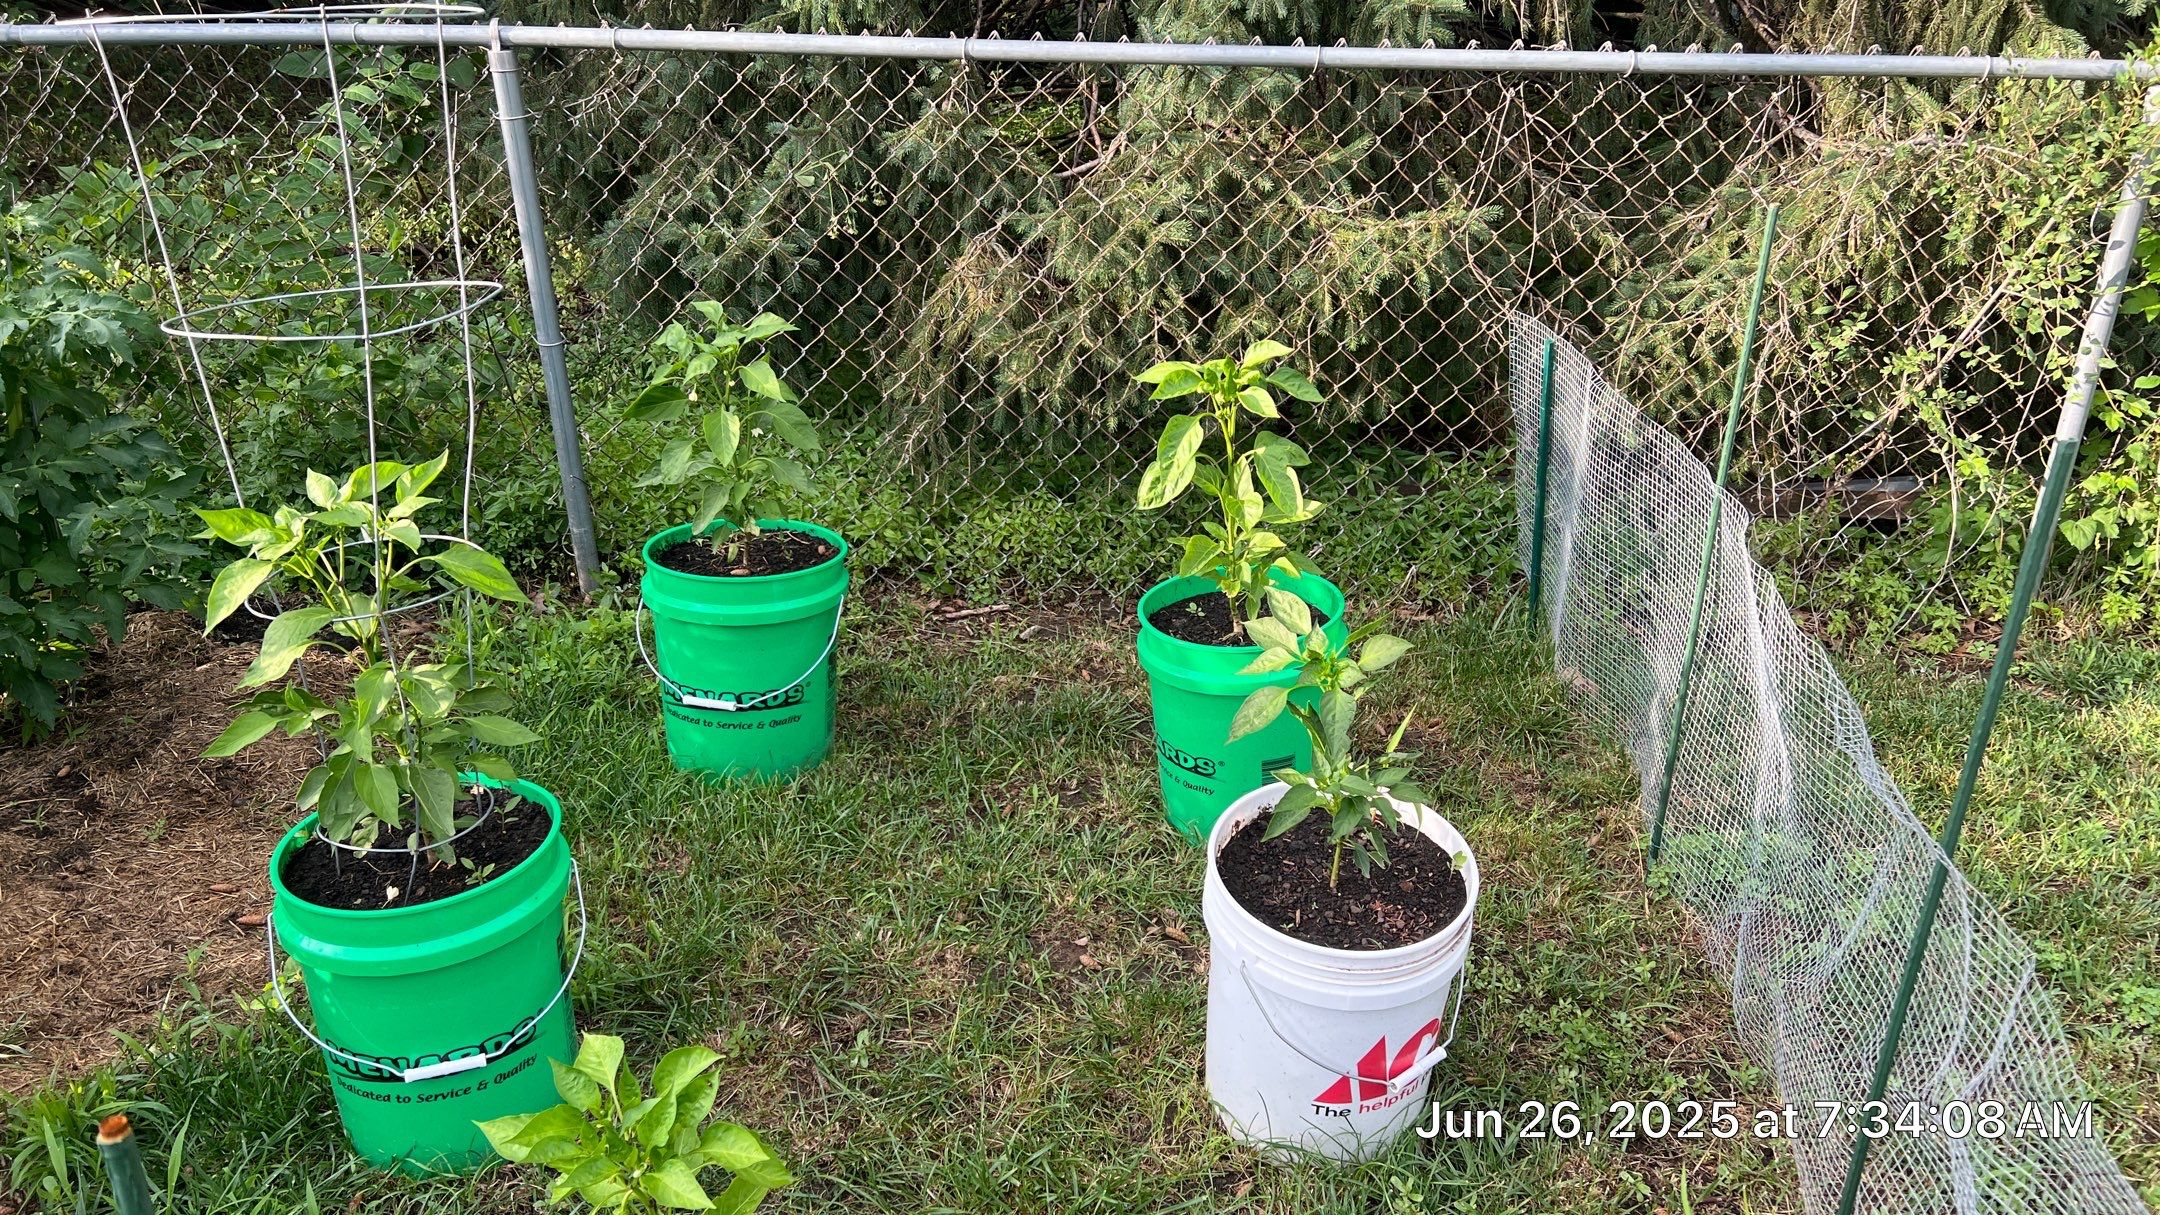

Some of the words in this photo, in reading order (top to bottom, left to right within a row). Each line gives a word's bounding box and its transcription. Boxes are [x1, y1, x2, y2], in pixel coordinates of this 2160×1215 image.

[703, 719, 713, 728] to
[716, 721, 753, 730] Service
[757, 721, 764, 729] &
[769, 714, 801, 728] Quality
[1183, 780, 1214, 796] Quality
[336, 1075, 391, 1103] Dedicated
[397, 1094, 411, 1104] to
[416, 1087, 471, 1103] Service
[477, 1080, 489, 1091] &
[494, 1053, 537, 1085] Quality
[1311, 1103, 1351, 1117] The
[1359, 1079, 1420, 1114] helpful
